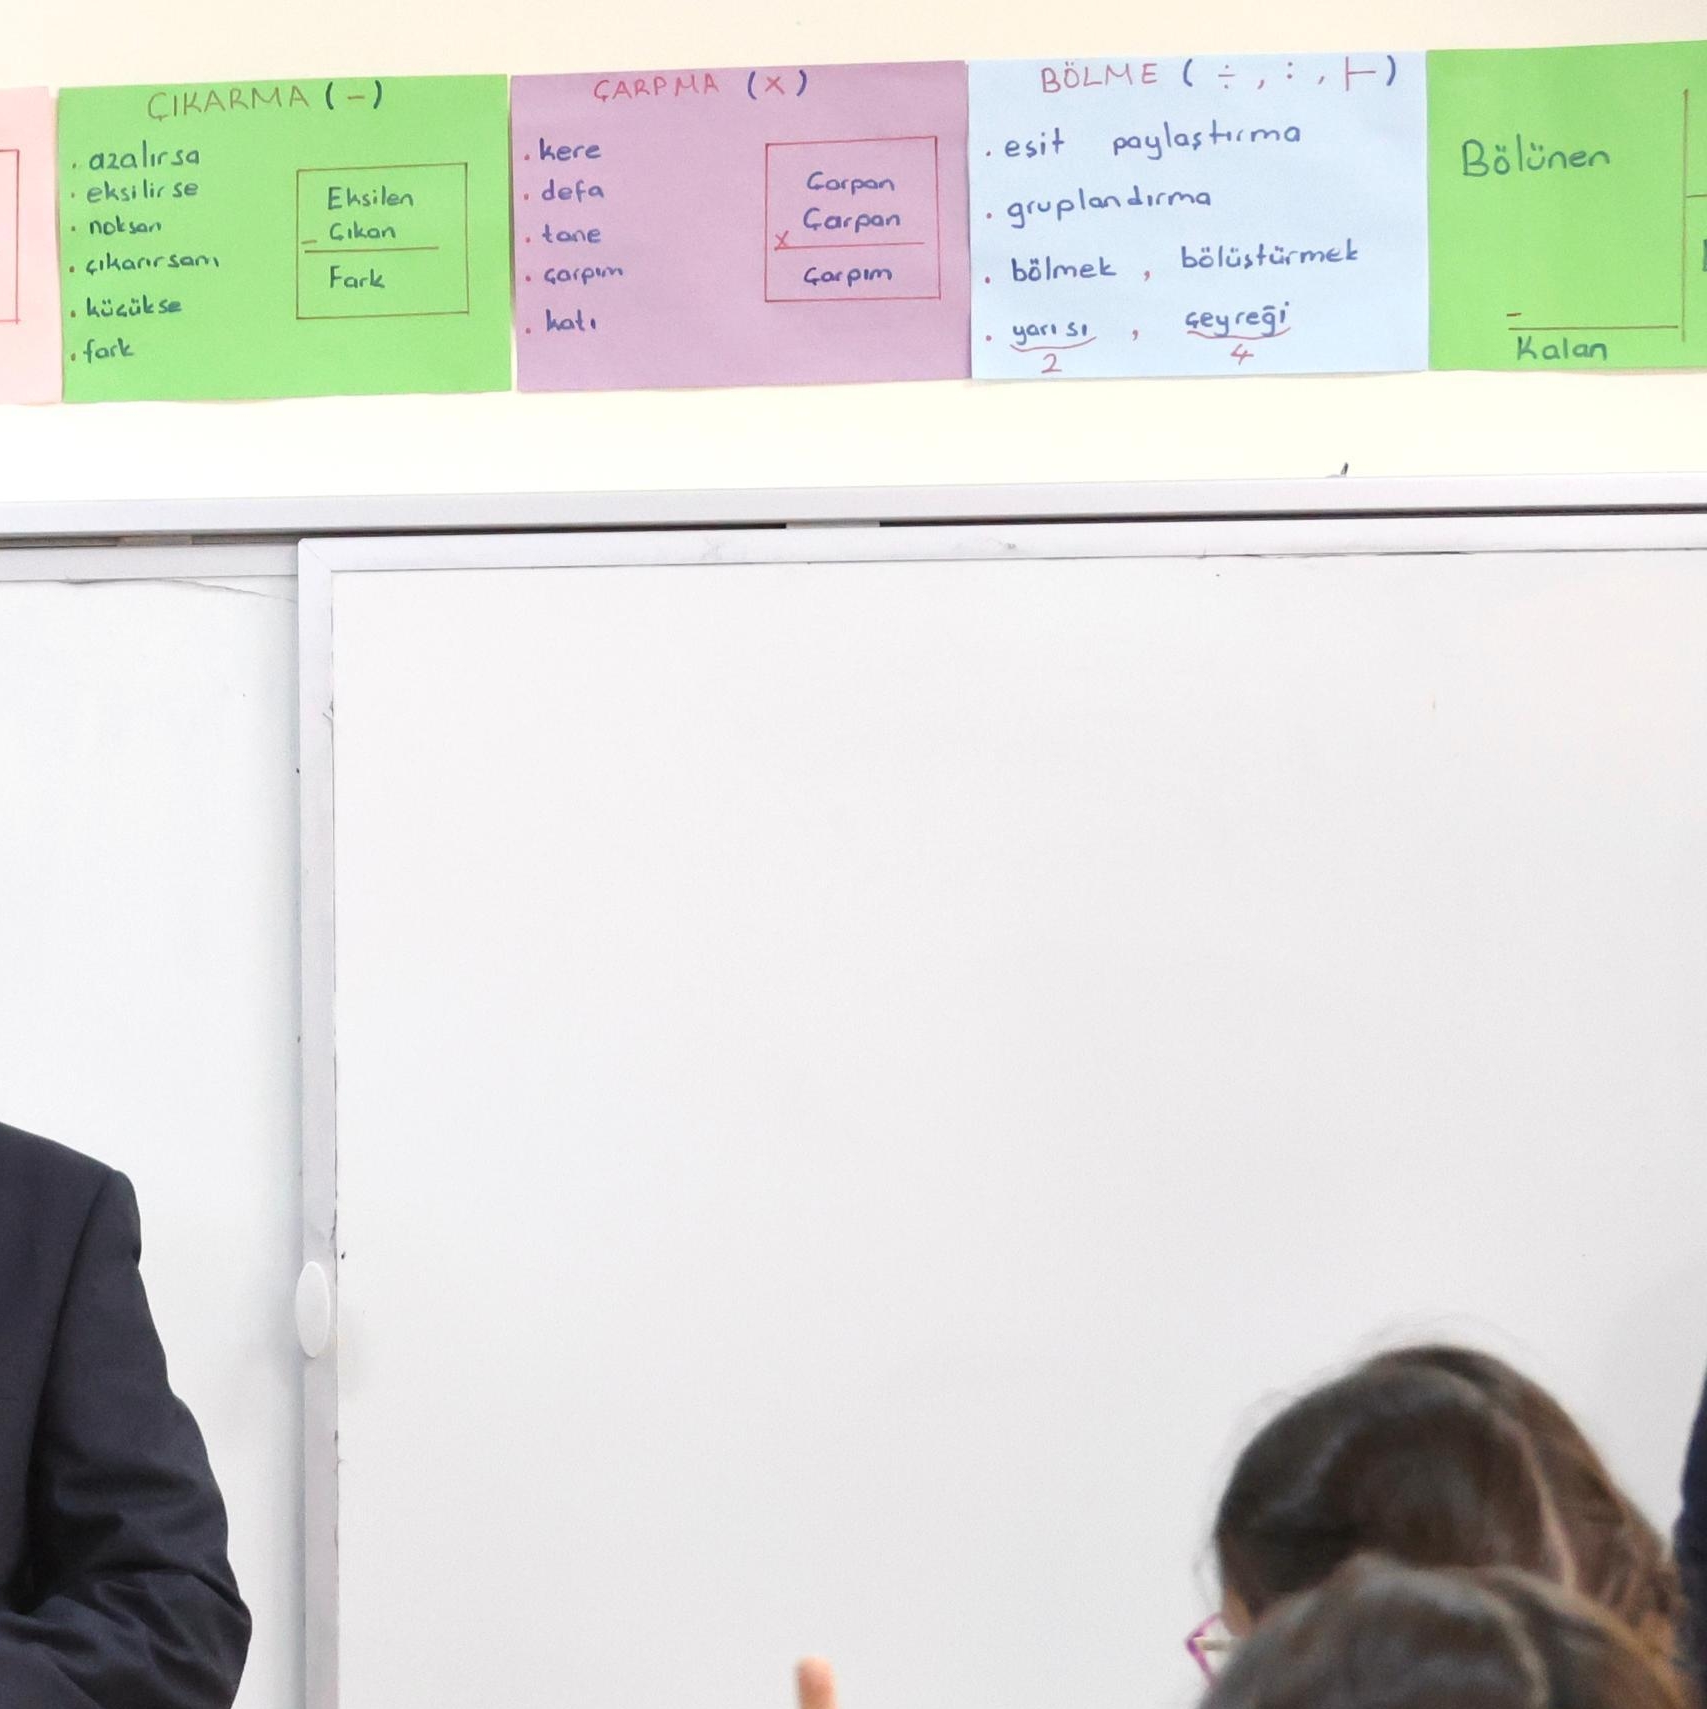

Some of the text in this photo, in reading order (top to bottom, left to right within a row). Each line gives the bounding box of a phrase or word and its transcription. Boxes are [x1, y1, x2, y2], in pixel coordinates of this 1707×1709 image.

[593, 73, 720, 102] ÇARPMA
[1041, 61, 1159, 94] BÖLME
[147, 85, 309, 121] ÇIKARMA
[539, 137, 601, 161] kere
[1112, 119, 1301, 160] paylaştırma
[89, 139, 200, 171] azalırsa
[1461, 134, 1611, 177] Bölünen
[87, 179, 199, 204] eksilirse
[327, 185, 414, 210] Eksilen
[541, 178, 605, 203] defa
[803, 207, 902, 233] Çarpan
[1007, 185, 1211, 229] gruplandırma
[89, 215, 162, 236] noksan
[329, 221, 397, 243] Çıkan
[542, 223, 602, 244] tane
[329, 265, 386, 290] Fark
[803, 266, 893, 288] Çarpım
[1011, 257, 1117, 283] bölmek
[1185, 301, 1290, 338] çeyreği
[83, 337, 135, 364] fark
[1041, 344, 1254, 374] 2 4
[1517, 336, 1608, 361] Kalan
